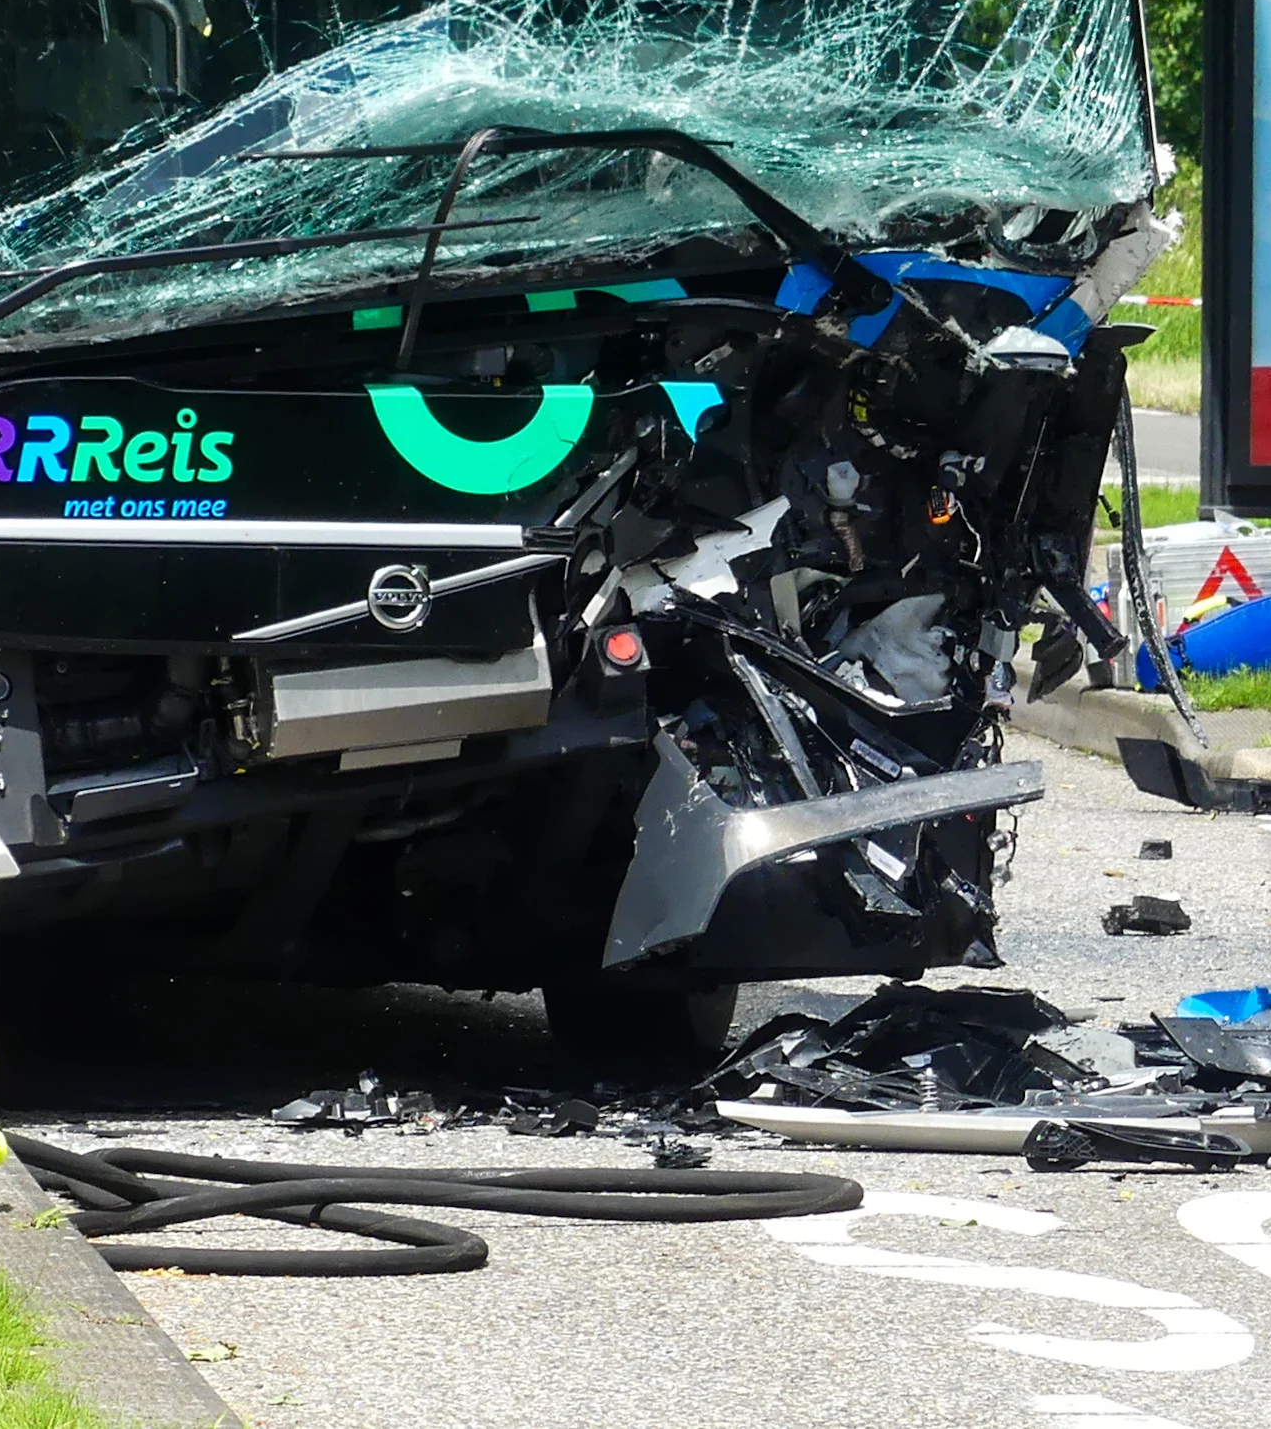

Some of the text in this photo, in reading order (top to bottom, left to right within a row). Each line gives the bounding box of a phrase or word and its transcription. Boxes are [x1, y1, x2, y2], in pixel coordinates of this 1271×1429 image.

[63, 494, 228, 519] met ons mee
